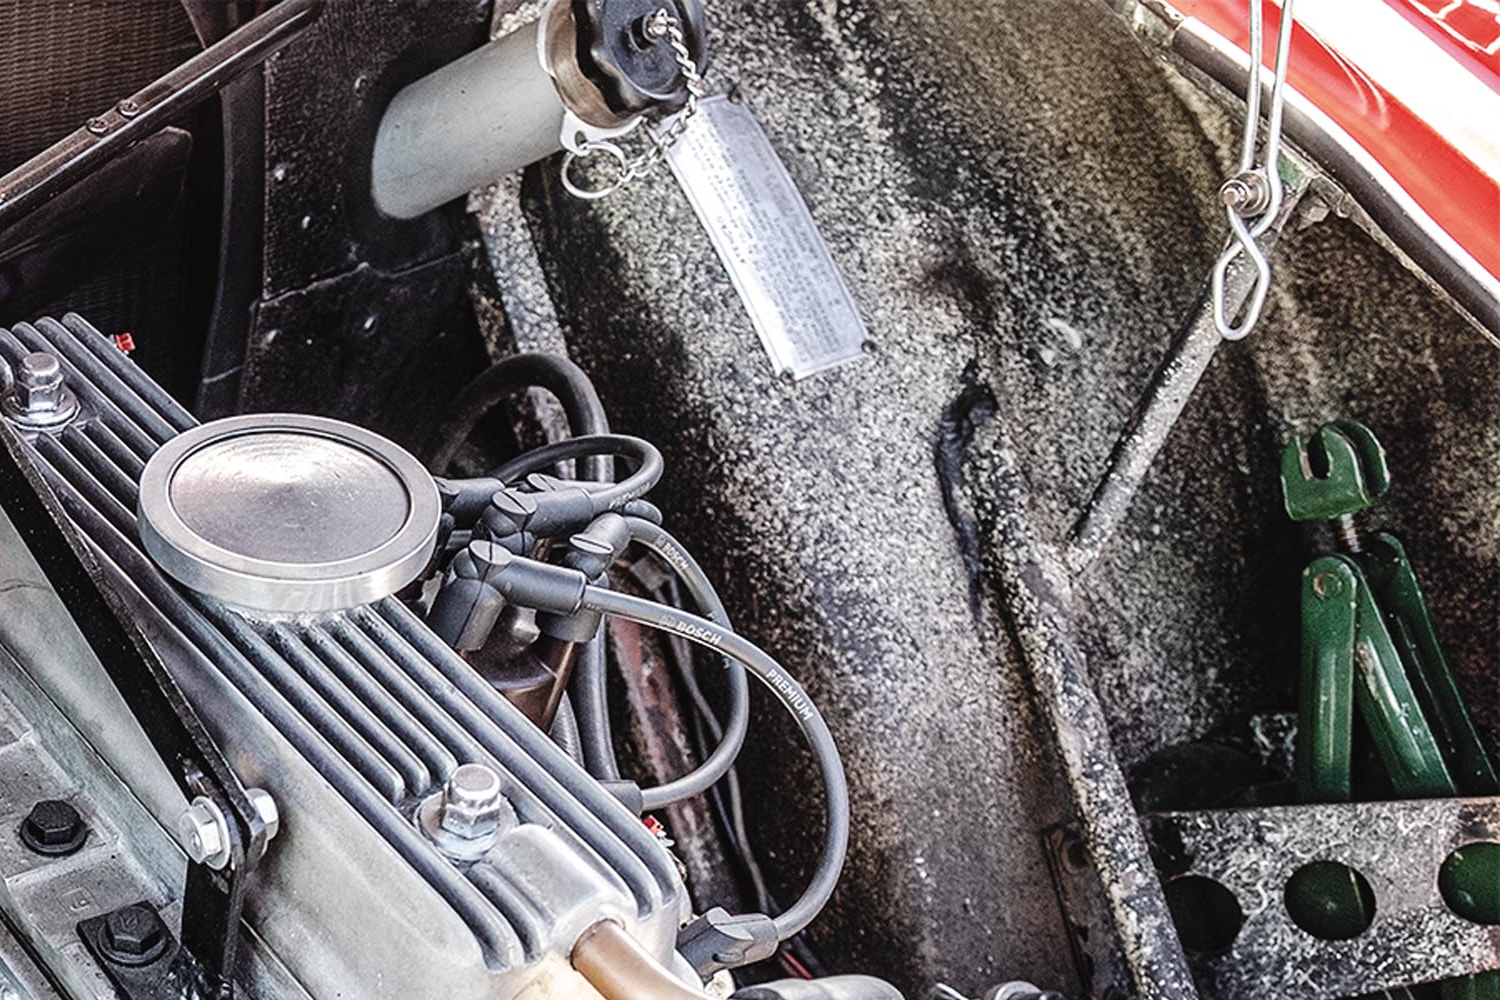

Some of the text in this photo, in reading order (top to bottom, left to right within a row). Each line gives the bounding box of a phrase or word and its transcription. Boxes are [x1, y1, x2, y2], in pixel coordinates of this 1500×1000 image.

[662, 541, 689, 570] BOSCH
[676, 620, 722, 645] BOSCH
[765, 668, 814, 721] PREMIUM
